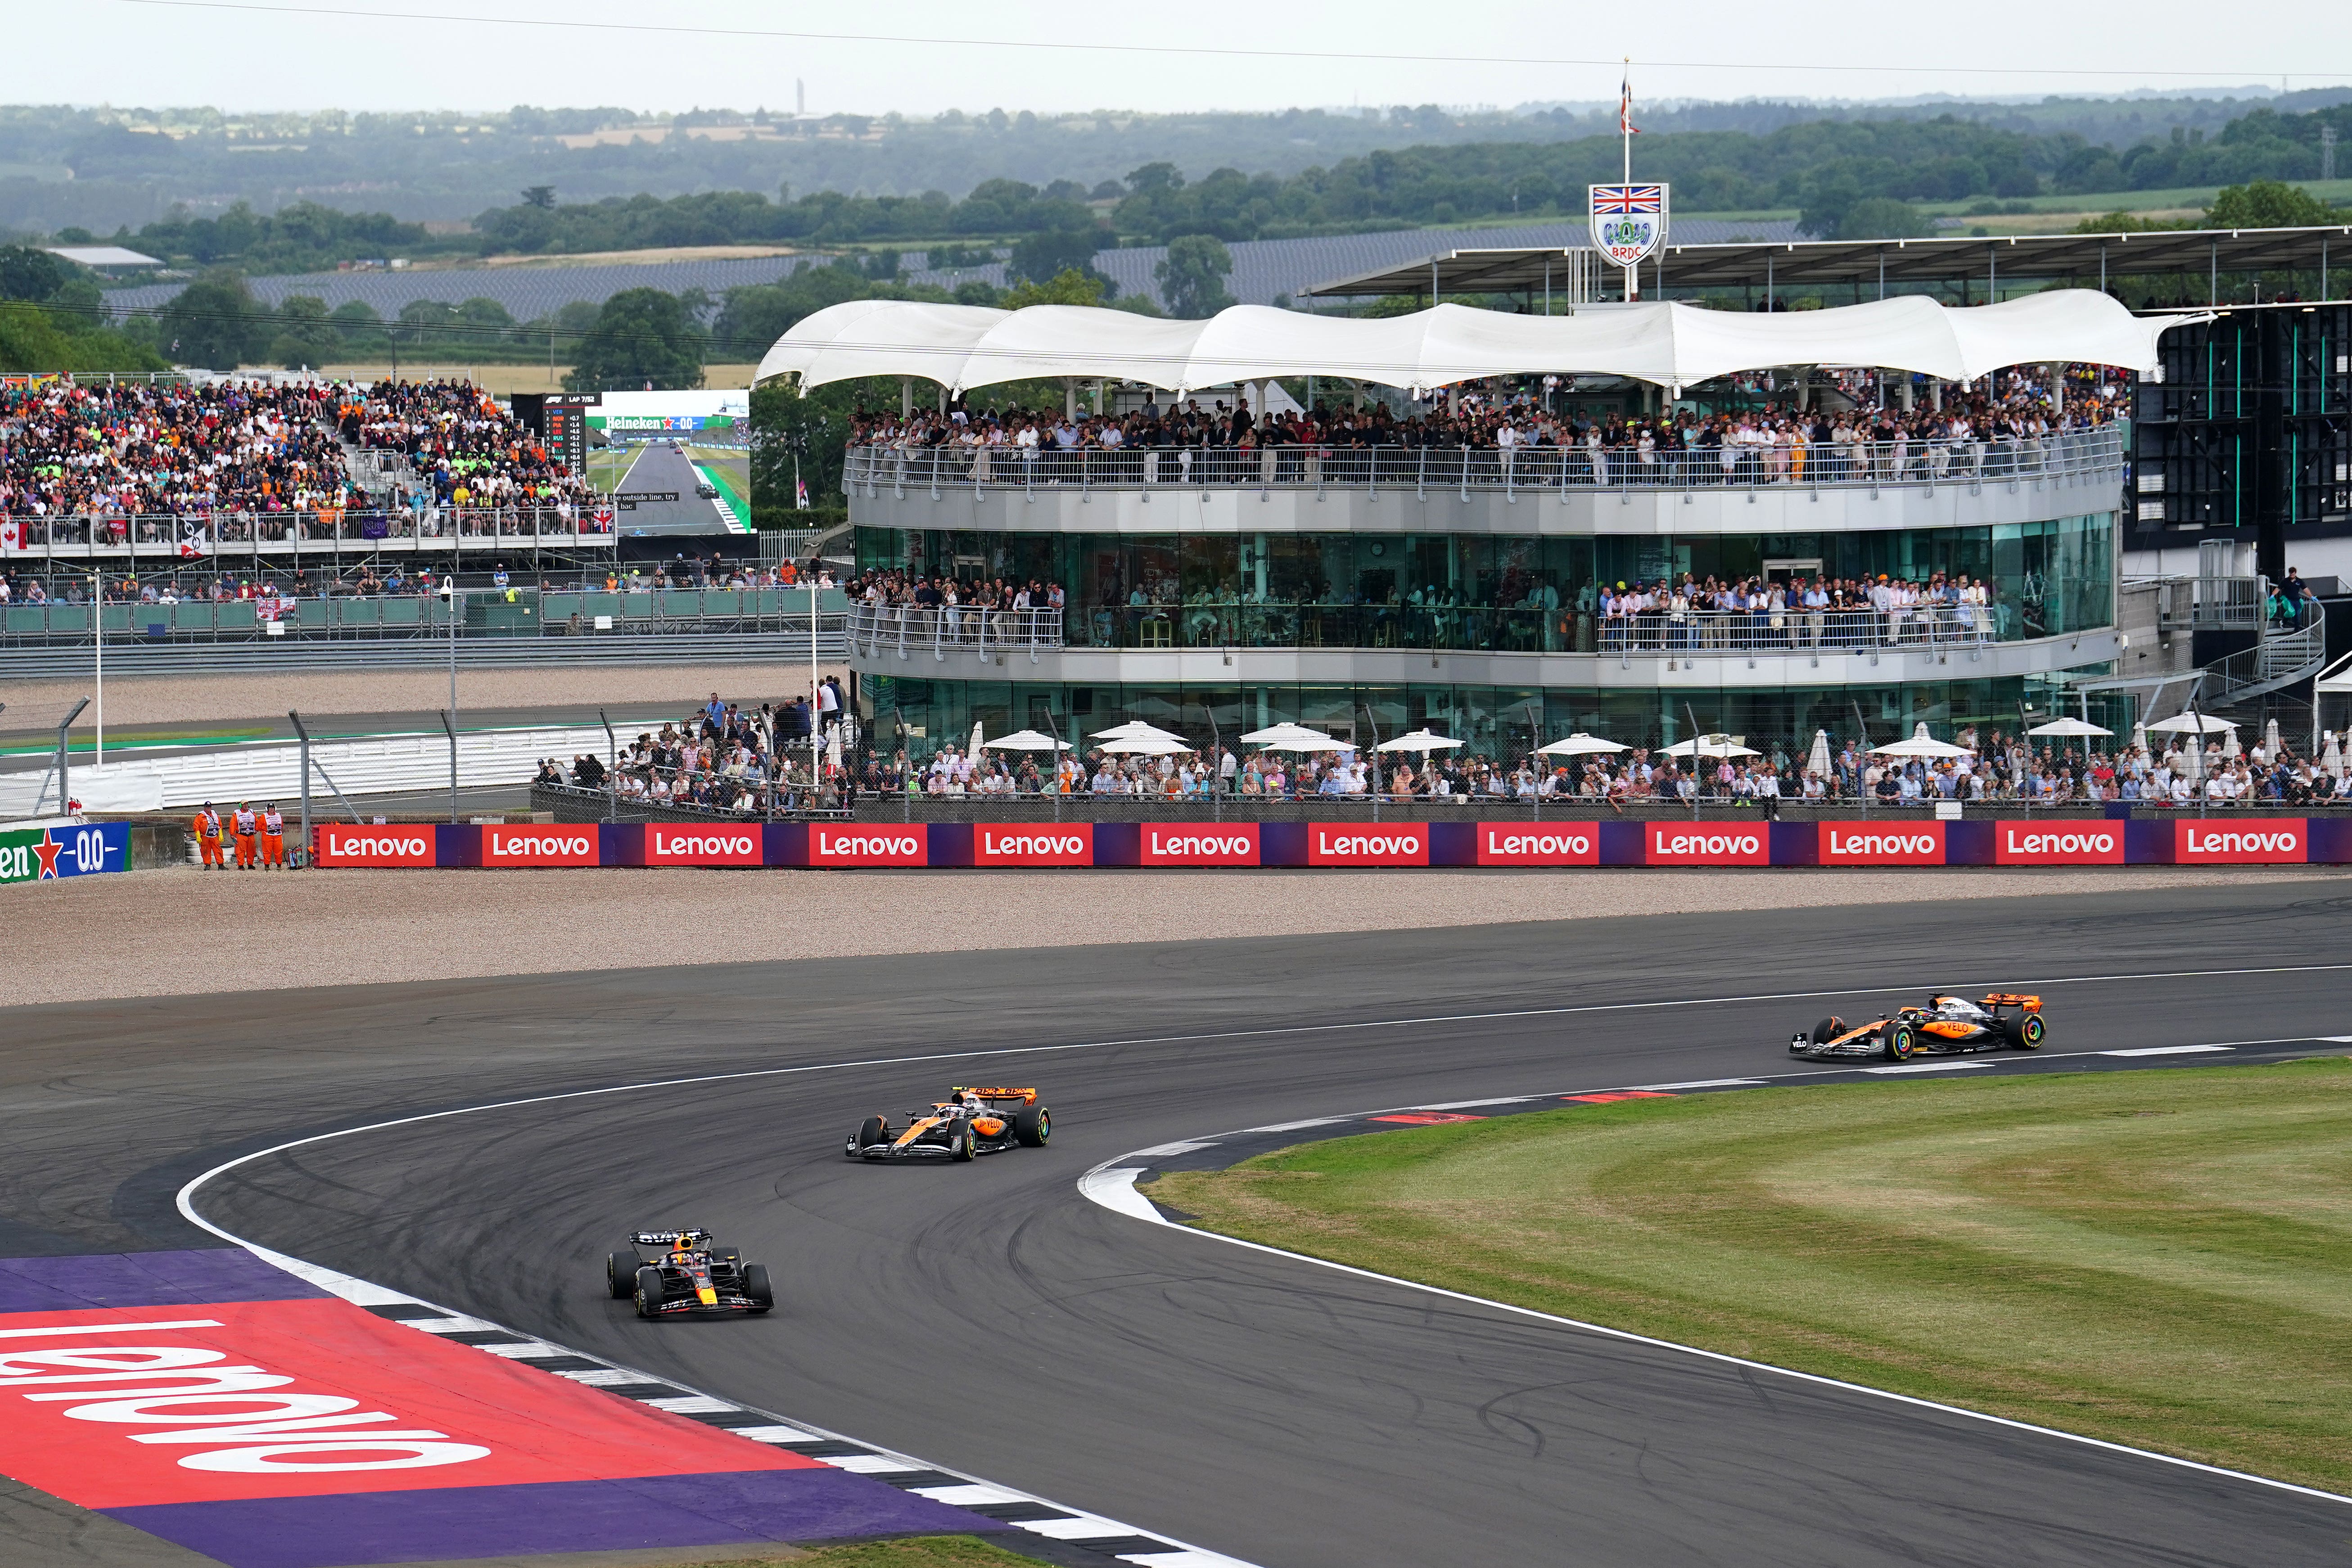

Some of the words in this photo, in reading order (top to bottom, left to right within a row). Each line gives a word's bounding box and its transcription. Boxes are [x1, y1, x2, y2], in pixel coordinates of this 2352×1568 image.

[1612, 247, 1641, 260] BRDC
[606, 416, 660, 429] Heineken
[77, 830, 104, 872] 0.0
[330, 834, 425, 855] Lenovo
[494, 834, 589, 855] Lenovo
[657, 833, 752, 854] Lenovo
[821, 833, 917, 854] Lenovo
[986, 833, 1083, 854] Lenovo
[1152, 832, 1250, 854] Lenovo
[1320, 832, 1418, 854] Lenovo
[1490, 832, 1589, 854] Lenovo
[1657, 831, 1758, 854] Lenovo
[1831, 831, 1934, 854] Lenovo
[2009, 831, 2113, 853] Lenovo
[2189, 829, 2296, 852] Lenovo
[0, 846, 30, 878] en
[1945, 1022, 1968, 1033] VELO
[987, 1119, 1000, 1129] VELO
